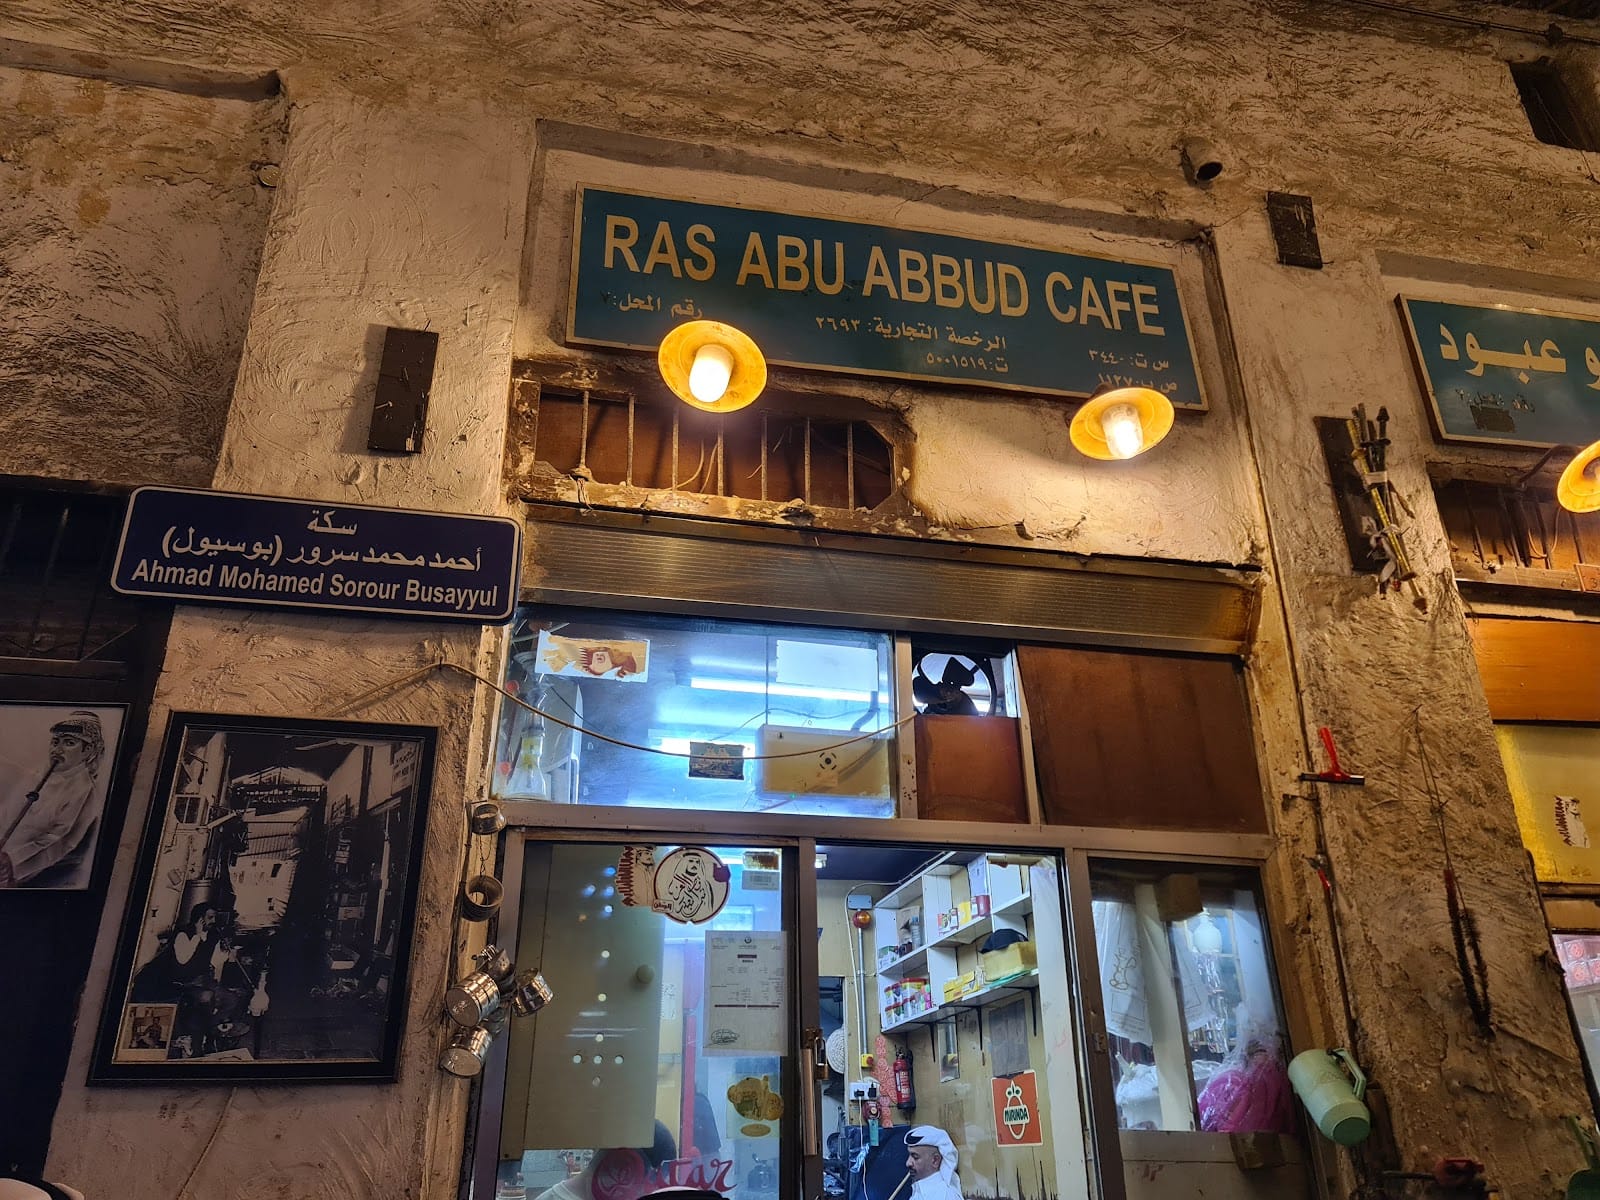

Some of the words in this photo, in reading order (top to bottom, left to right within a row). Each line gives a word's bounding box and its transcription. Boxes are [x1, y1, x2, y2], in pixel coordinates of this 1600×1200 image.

[604, 214, 717, 282] RAS
[736, 231, 845, 296] ABU
[862, 245, 1029, 318] ABBUD
[1045, 271, 1166, 337] CAFE
[671, 298, 703, 320] رقم
[868, 316, 939, 341] التجارية:
[947, 326, 1007, 352] الرخصة
[1152, 360, 1169, 372] س
[1440, 323, 1567, 385] عبود
[306, 510, 358, 536] سكة
[286, 546, 359, 567] سرور
[362, 547, 425, 567] محمد
[429, 547, 482, 572] أحمد
[131, 558, 214, 587] Ahmad
[218, 564, 324, 595] Mohamed
[329, 572, 401, 600] Sorour
[405, 579, 498, 611] Busayyul
